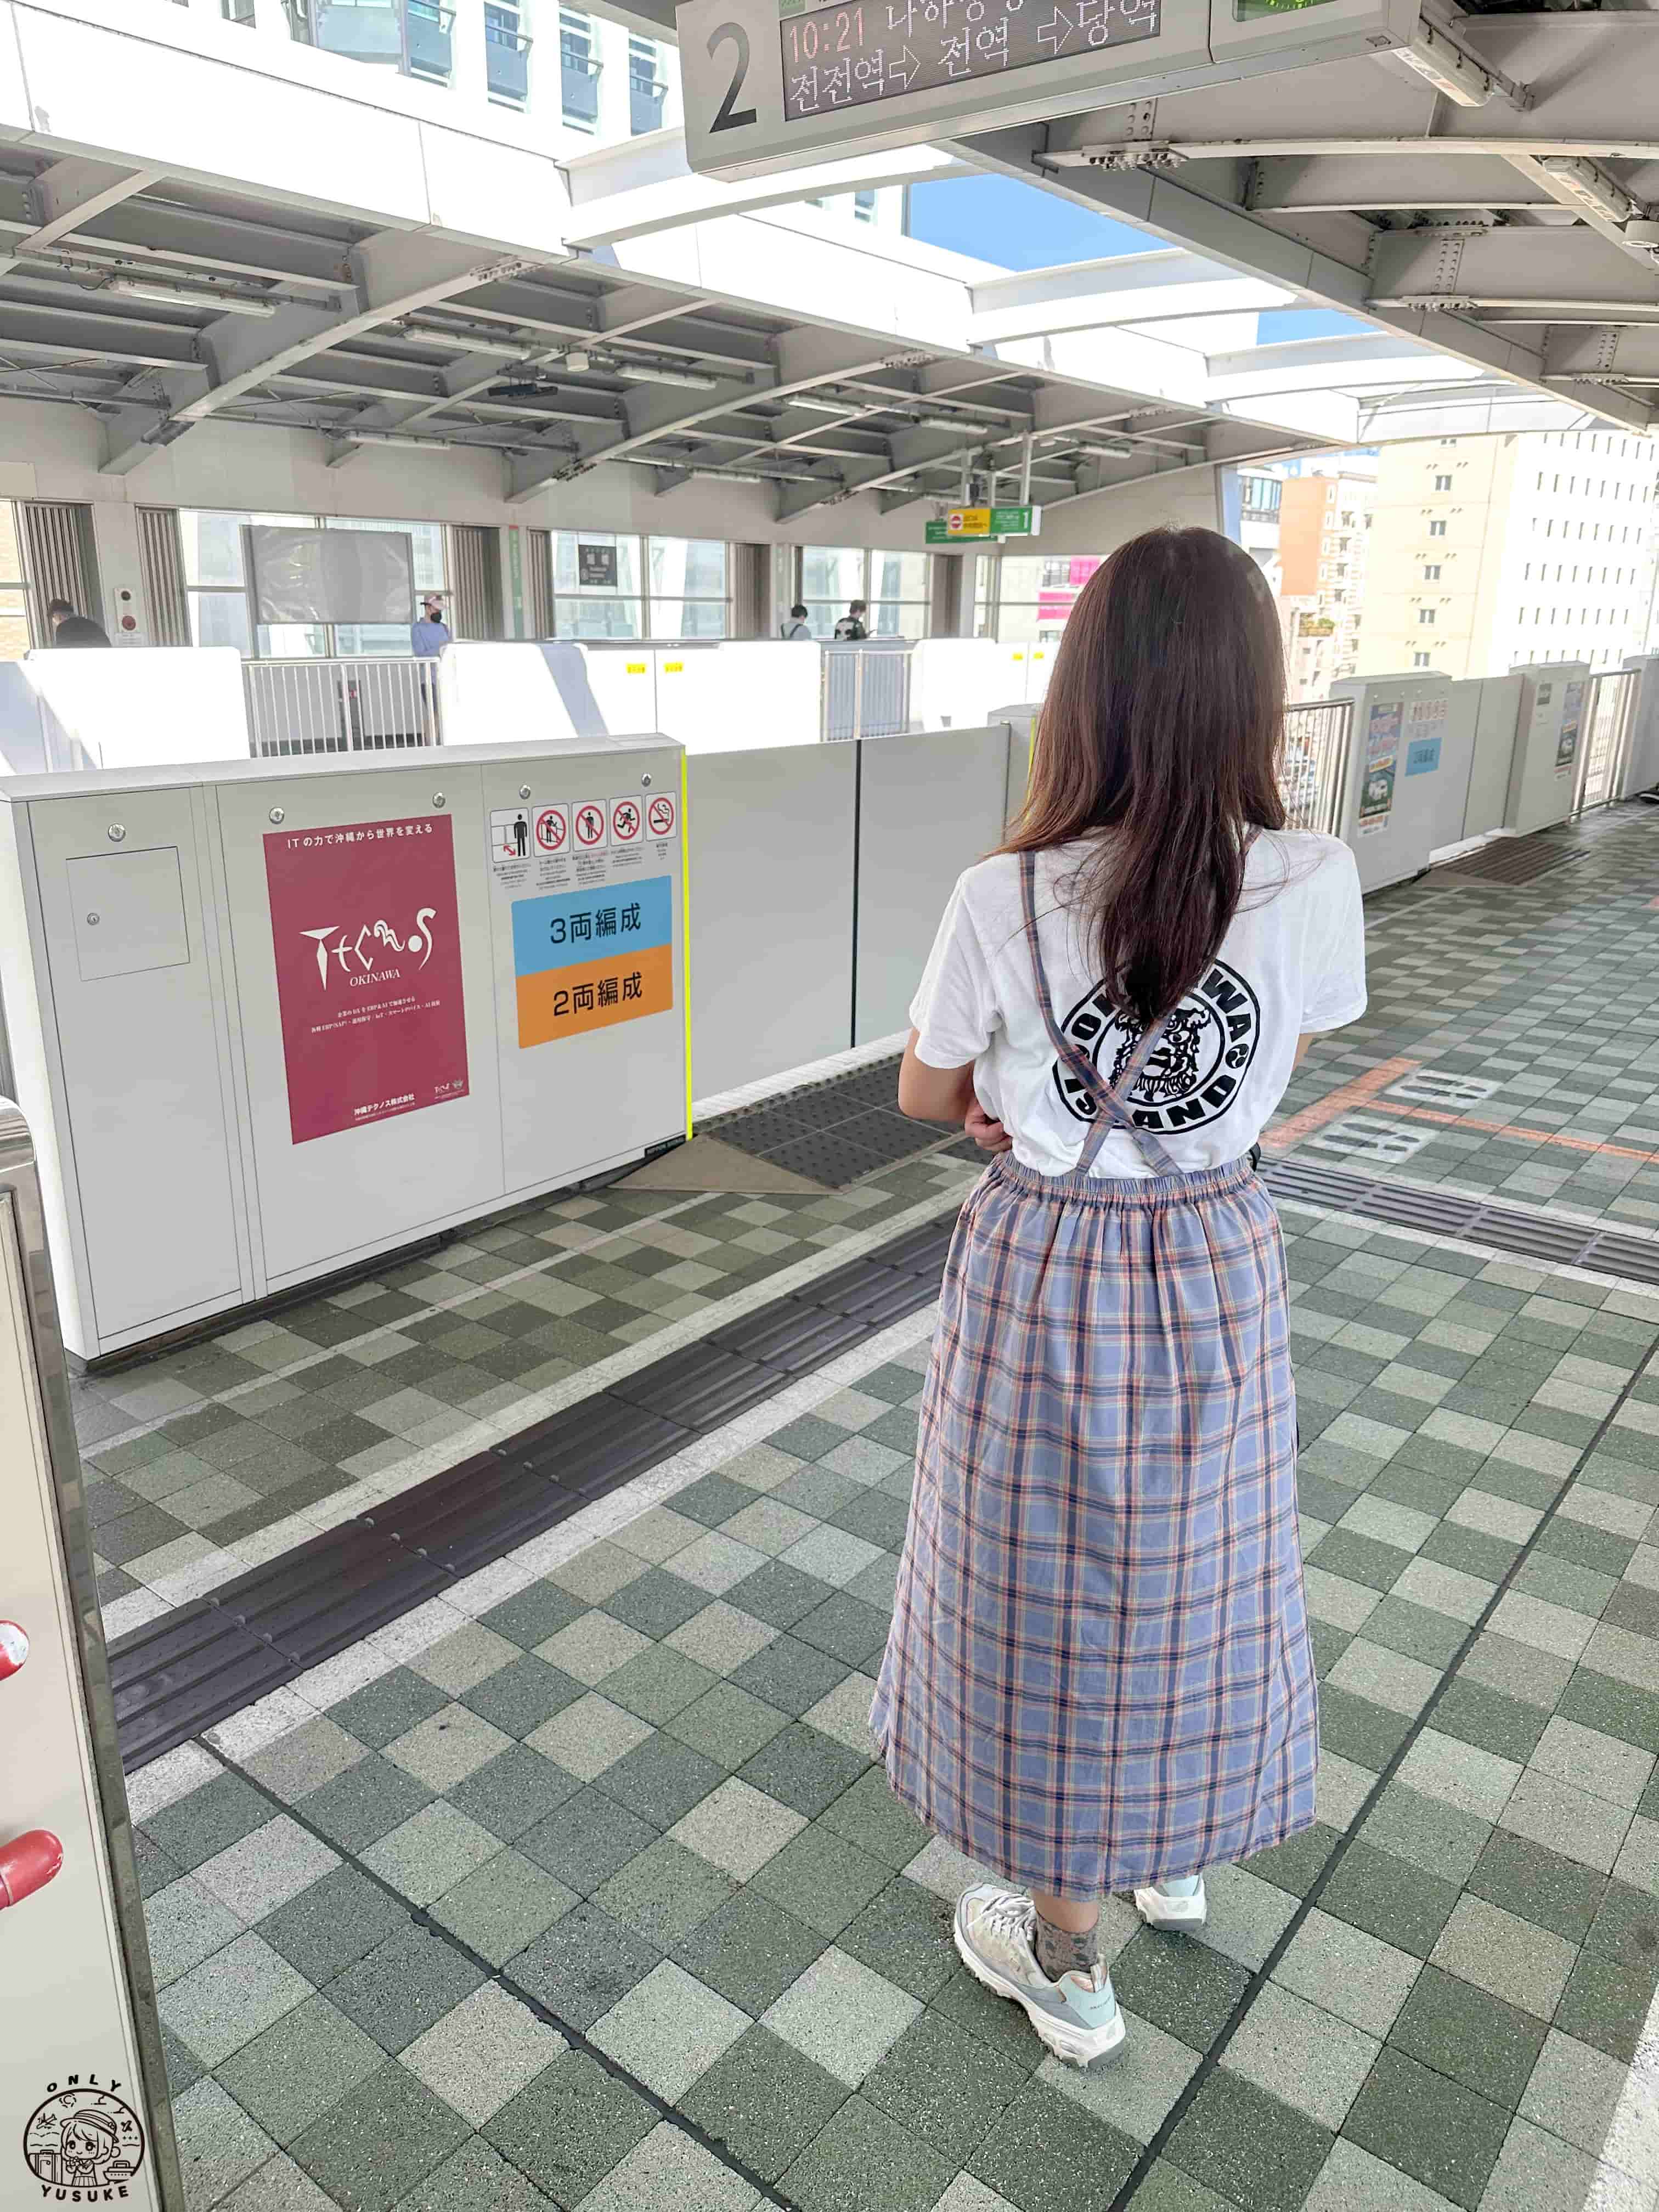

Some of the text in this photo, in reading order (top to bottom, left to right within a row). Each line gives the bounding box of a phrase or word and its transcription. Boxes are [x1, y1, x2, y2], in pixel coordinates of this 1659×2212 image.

[790, 7, 864, 63] 10:21
[706, 22, 757, 134] 2
[790, 48, 885, 111] 전전역
[938, 17, 1009, 77] 전역
[550, 903, 641, 944] 3両編成
[349, 968, 400, 986] OKINAWA
[553, 972, 642, 1016] 2両編成
[1064, 1074, 1237, 1129] ISAND
